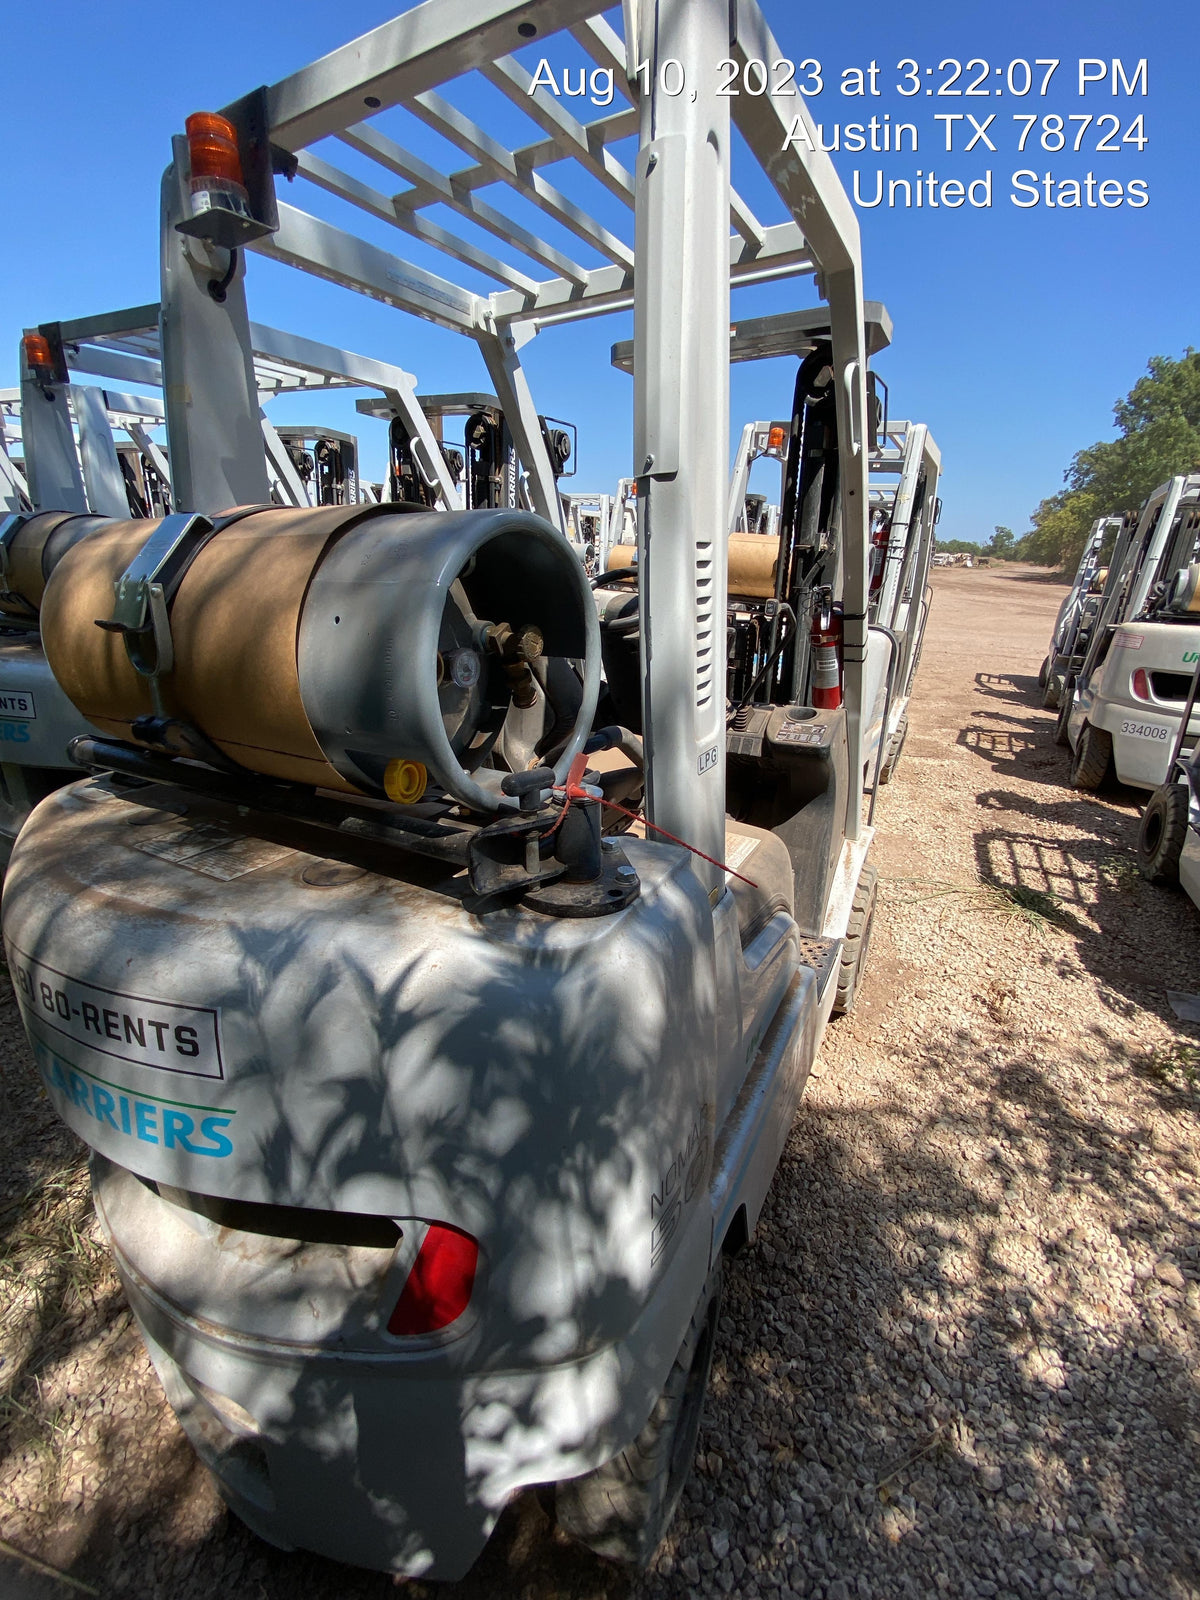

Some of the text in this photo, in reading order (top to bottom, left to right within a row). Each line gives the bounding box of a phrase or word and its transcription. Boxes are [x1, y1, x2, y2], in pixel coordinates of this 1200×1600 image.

[0, 722, 31, 743] RS
[1121, 722, 1168, 740] 334008
[699, 748, 718, 772] LPG
[40, 982, 200, 1058] 80-RENTS
